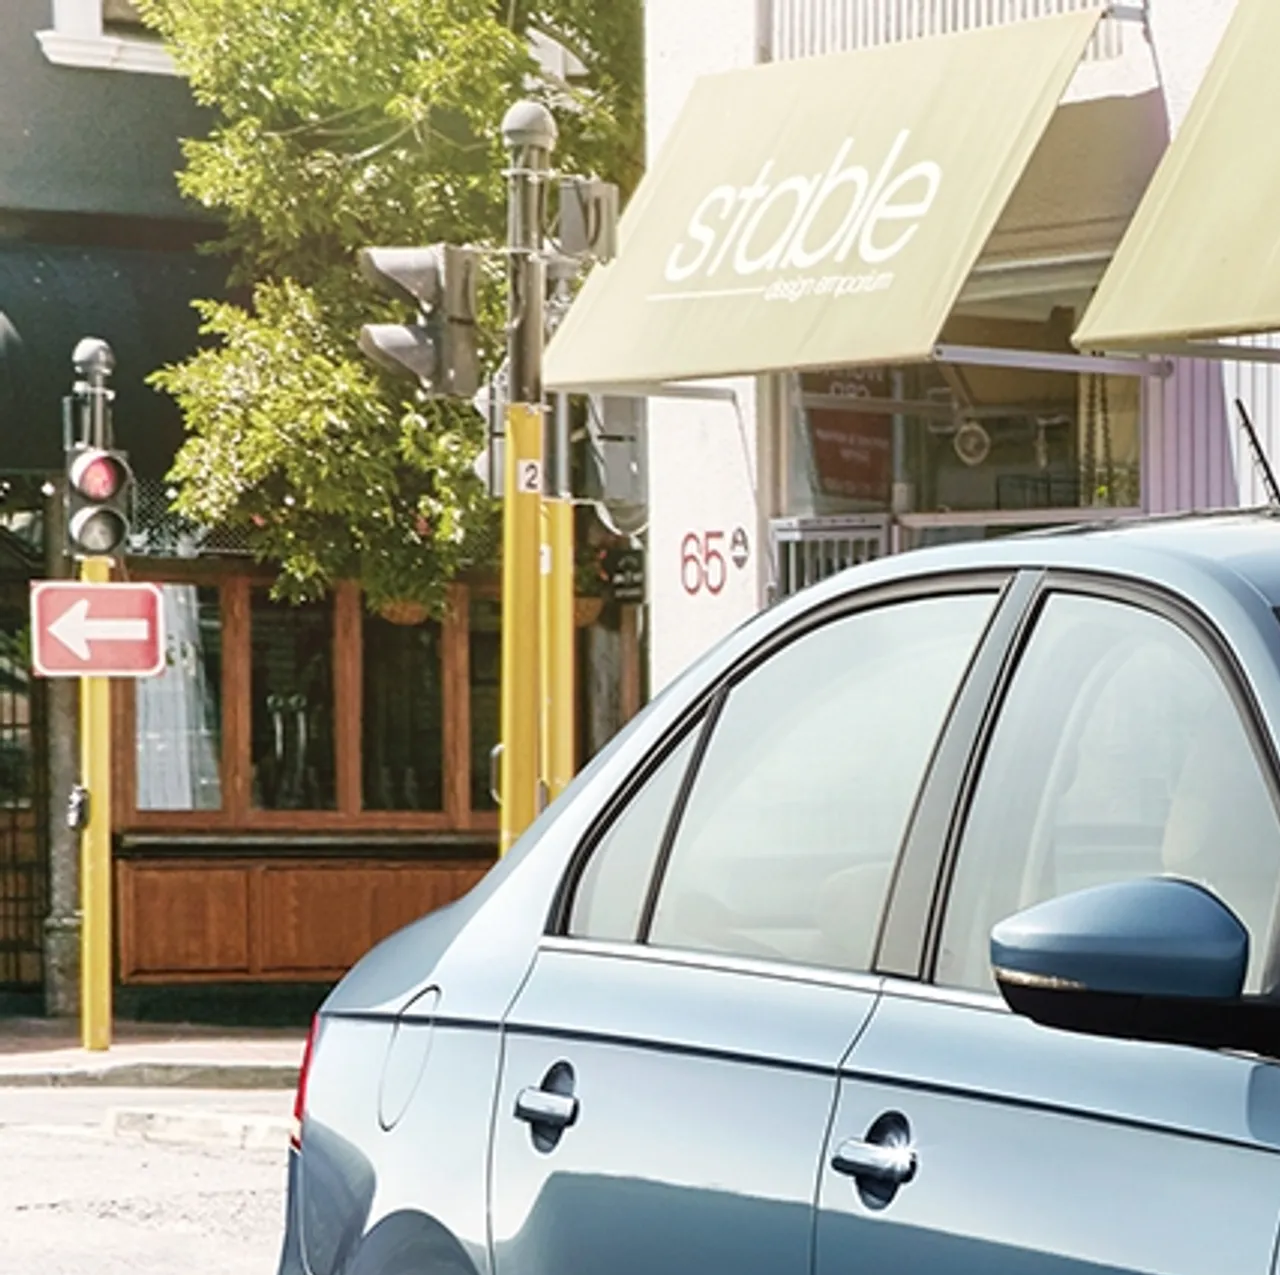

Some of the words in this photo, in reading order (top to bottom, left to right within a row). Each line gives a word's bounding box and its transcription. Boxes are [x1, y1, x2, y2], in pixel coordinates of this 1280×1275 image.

[665, 129, 942, 281] stable
[525, 463, 538, 490] 2
[681, 530, 727, 595] 65
